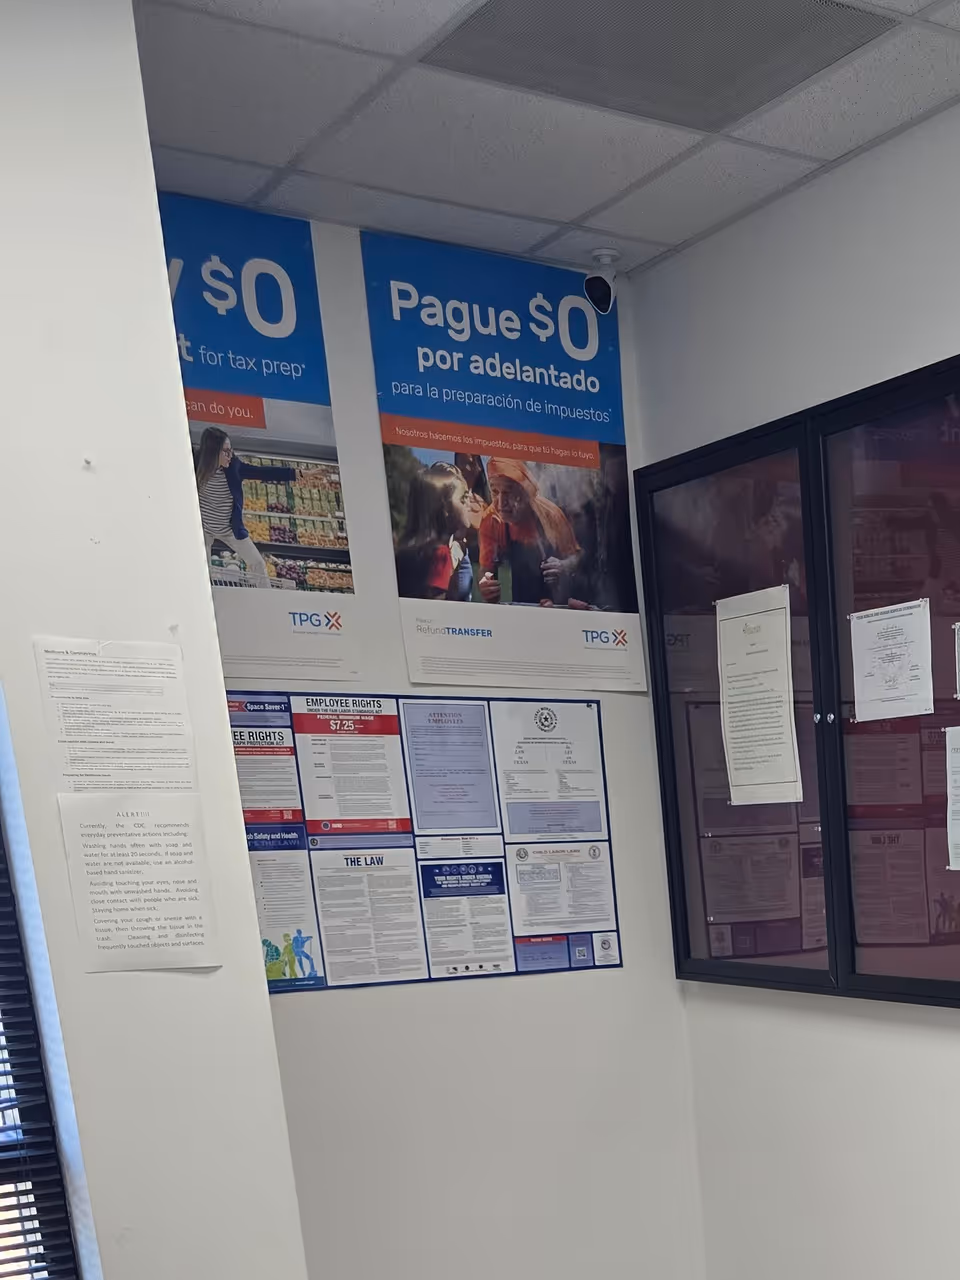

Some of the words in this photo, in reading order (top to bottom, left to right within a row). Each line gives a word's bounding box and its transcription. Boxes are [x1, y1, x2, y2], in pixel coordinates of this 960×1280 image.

[201, 255, 297, 338] $0
[390, 280, 521, 342] Pague
[528, 292, 599, 361] $0
[199, 346, 224, 365] for
[228, 350, 257, 371] tax
[417, 346, 463, 372] por
[469, 352, 600, 393] adelantado
[392, 381, 423, 396] para
[427, 383, 438, 399] la
[443, 388, 522, 410] preparación
[526, 398, 541, 413] de
[210, 401, 224, 414] do
[228, 407, 253, 418] you.
[396, 427, 428, 439] Nosotros
[463, 436, 473, 444] los
[474, 437, 511, 449] impuestos,
[513, 442, 528, 451] para
[529, 446, 541, 454] que
[551, 446, 570, 457] hagas
[571, 448, 577, 457] lo
[579, 451, 594, 460] tuyo.
[289, 612, 321, 627] TPG
[416, 624, 492, 637] RefundTRANSFER
[582, 630, 609, 643] TPG
[306, 698, 350, 708] EMPLOYEE
[352, 700, 382, 708] RIGHTS
[330, 720, 354, 730] $7.25
[248, 731, 284, 741] RIGHTS
[344, 857, 362, 866] THE
[364, 856, 384, 866] LAW
